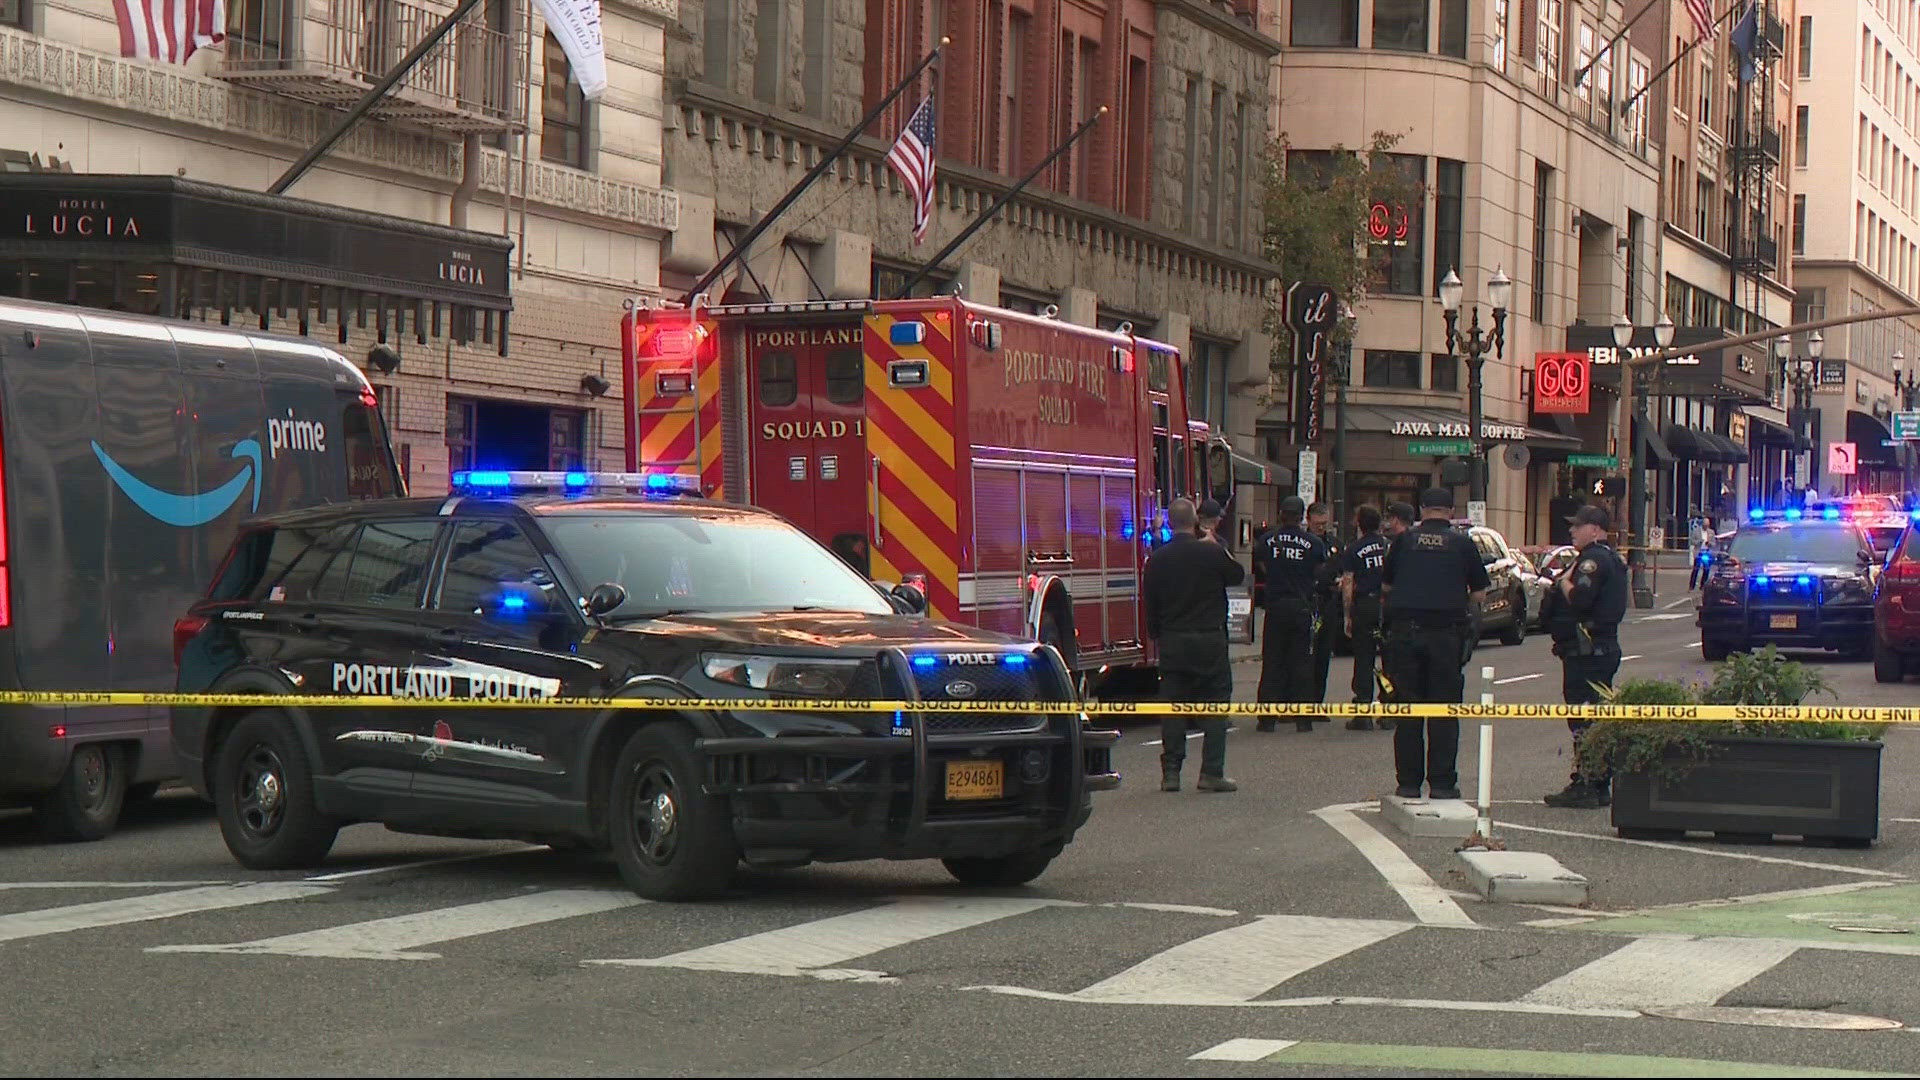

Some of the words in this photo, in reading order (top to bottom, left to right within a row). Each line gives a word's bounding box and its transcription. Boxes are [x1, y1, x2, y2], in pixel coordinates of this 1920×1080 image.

[26, 214, 139, 236] LUCIA
[439, 262, 484, 285] LUCIA
[756, 328, 863, 347] PORTLAND
[1005, 349, 1074, 387] PORTLAND
[1079, 361, 1107, 403] FIRE
[1039, 395, 1071, 424] SQUAD
[1073, 402, 1078, 425] 1
[268, 408, 325, 459] prime
[763, 421, 847, 440] SQUAD
[856, 421, 863, 436] 1
[1391, 421, 1432, 436] JAVA
[1481, 424, 1525, 440] COFFEE
[1266, 534, 1312, 550] PRTLAND
[1418, 537, 1443, 546] POLICE
[948, 653, 996, 665] POLICE
[333, 663, 451, 697] PORTLAND
[1171, 703, 1231, 712] CROSS
[1236, 703, 1271, 713] NOT
[1275, 704, 1301, 714] DO
[1306, 704, 1343, 714] LINE
[1348, 704, 1411, 715] POLICE
[1447, 704, 1509, 716] CROSS
[1514, 705, 1550, 716] NOT
[1556, 706, 1582, 716] DO
[1587, 706, 1627, 717] LINE
[1632, 706, 1697, 718] POLICE
[1735, 706, 1800, 718] CROSS
[1806, 707, 1843, 719] NOT
[1849, 708, 1876, 720] DO
[949, 770, 999, 787] E294861
